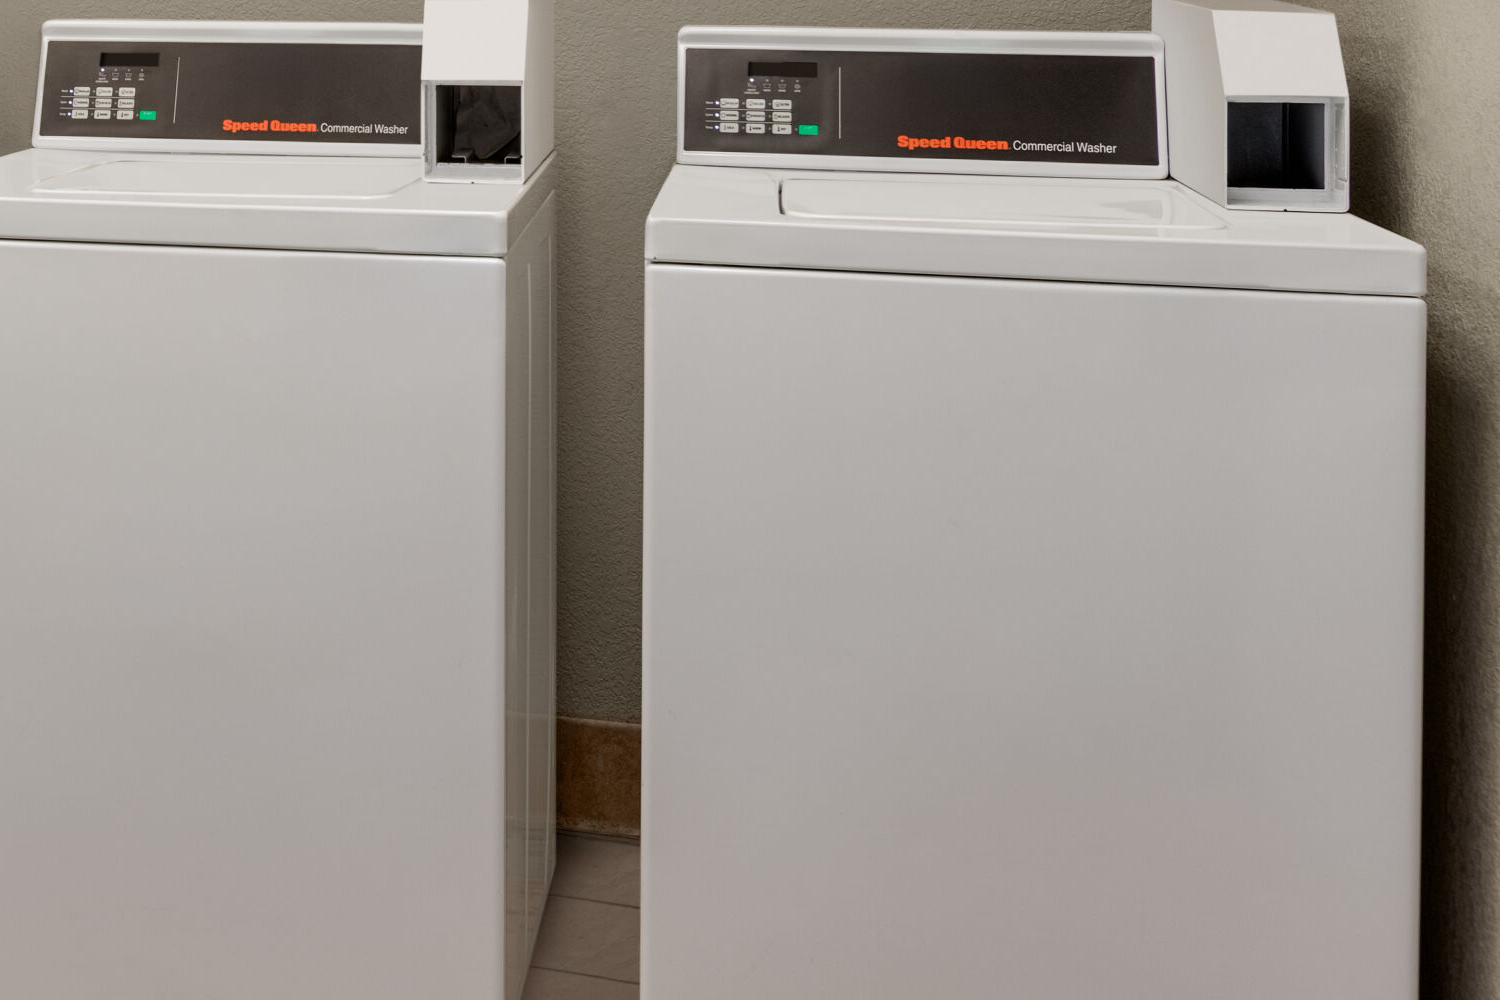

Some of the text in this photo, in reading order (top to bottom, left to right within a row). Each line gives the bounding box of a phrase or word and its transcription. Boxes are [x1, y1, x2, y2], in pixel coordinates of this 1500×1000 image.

[222, 119, 409, 135] Speed Queen Commercial Washer
[897, 135, 1117, 154] Speed Queen Commercial Washer
